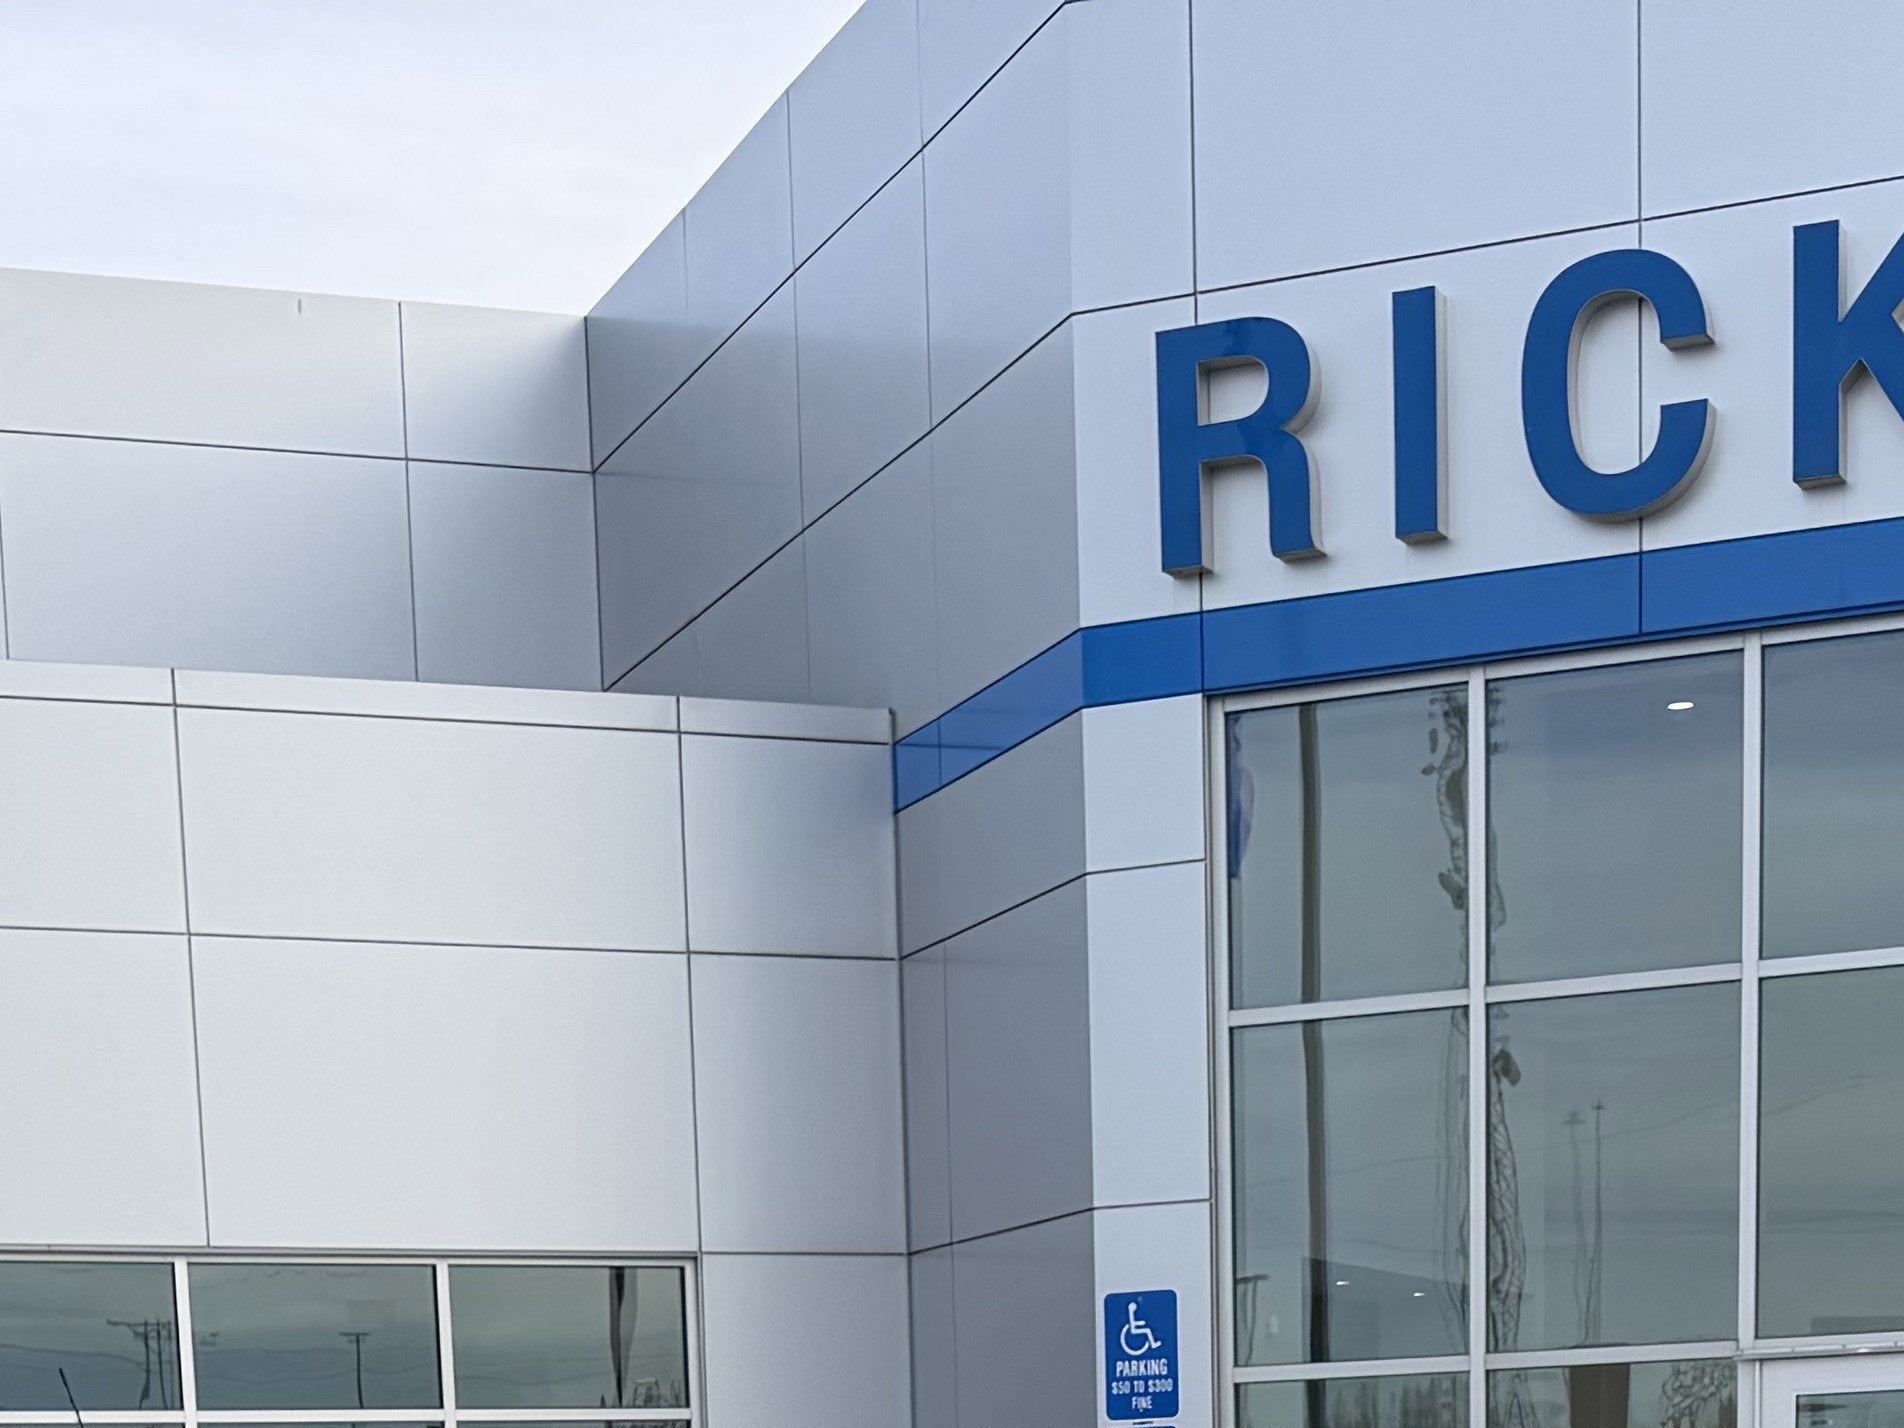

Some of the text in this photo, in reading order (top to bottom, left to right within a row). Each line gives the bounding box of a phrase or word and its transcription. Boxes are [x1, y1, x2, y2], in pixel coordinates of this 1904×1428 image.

[1116, 1358, 1168, 1378] PARKING
[1111, 1378, 1174, 1394] $50 TO $300
[1131, 1396, 1153, 1410] FINE
